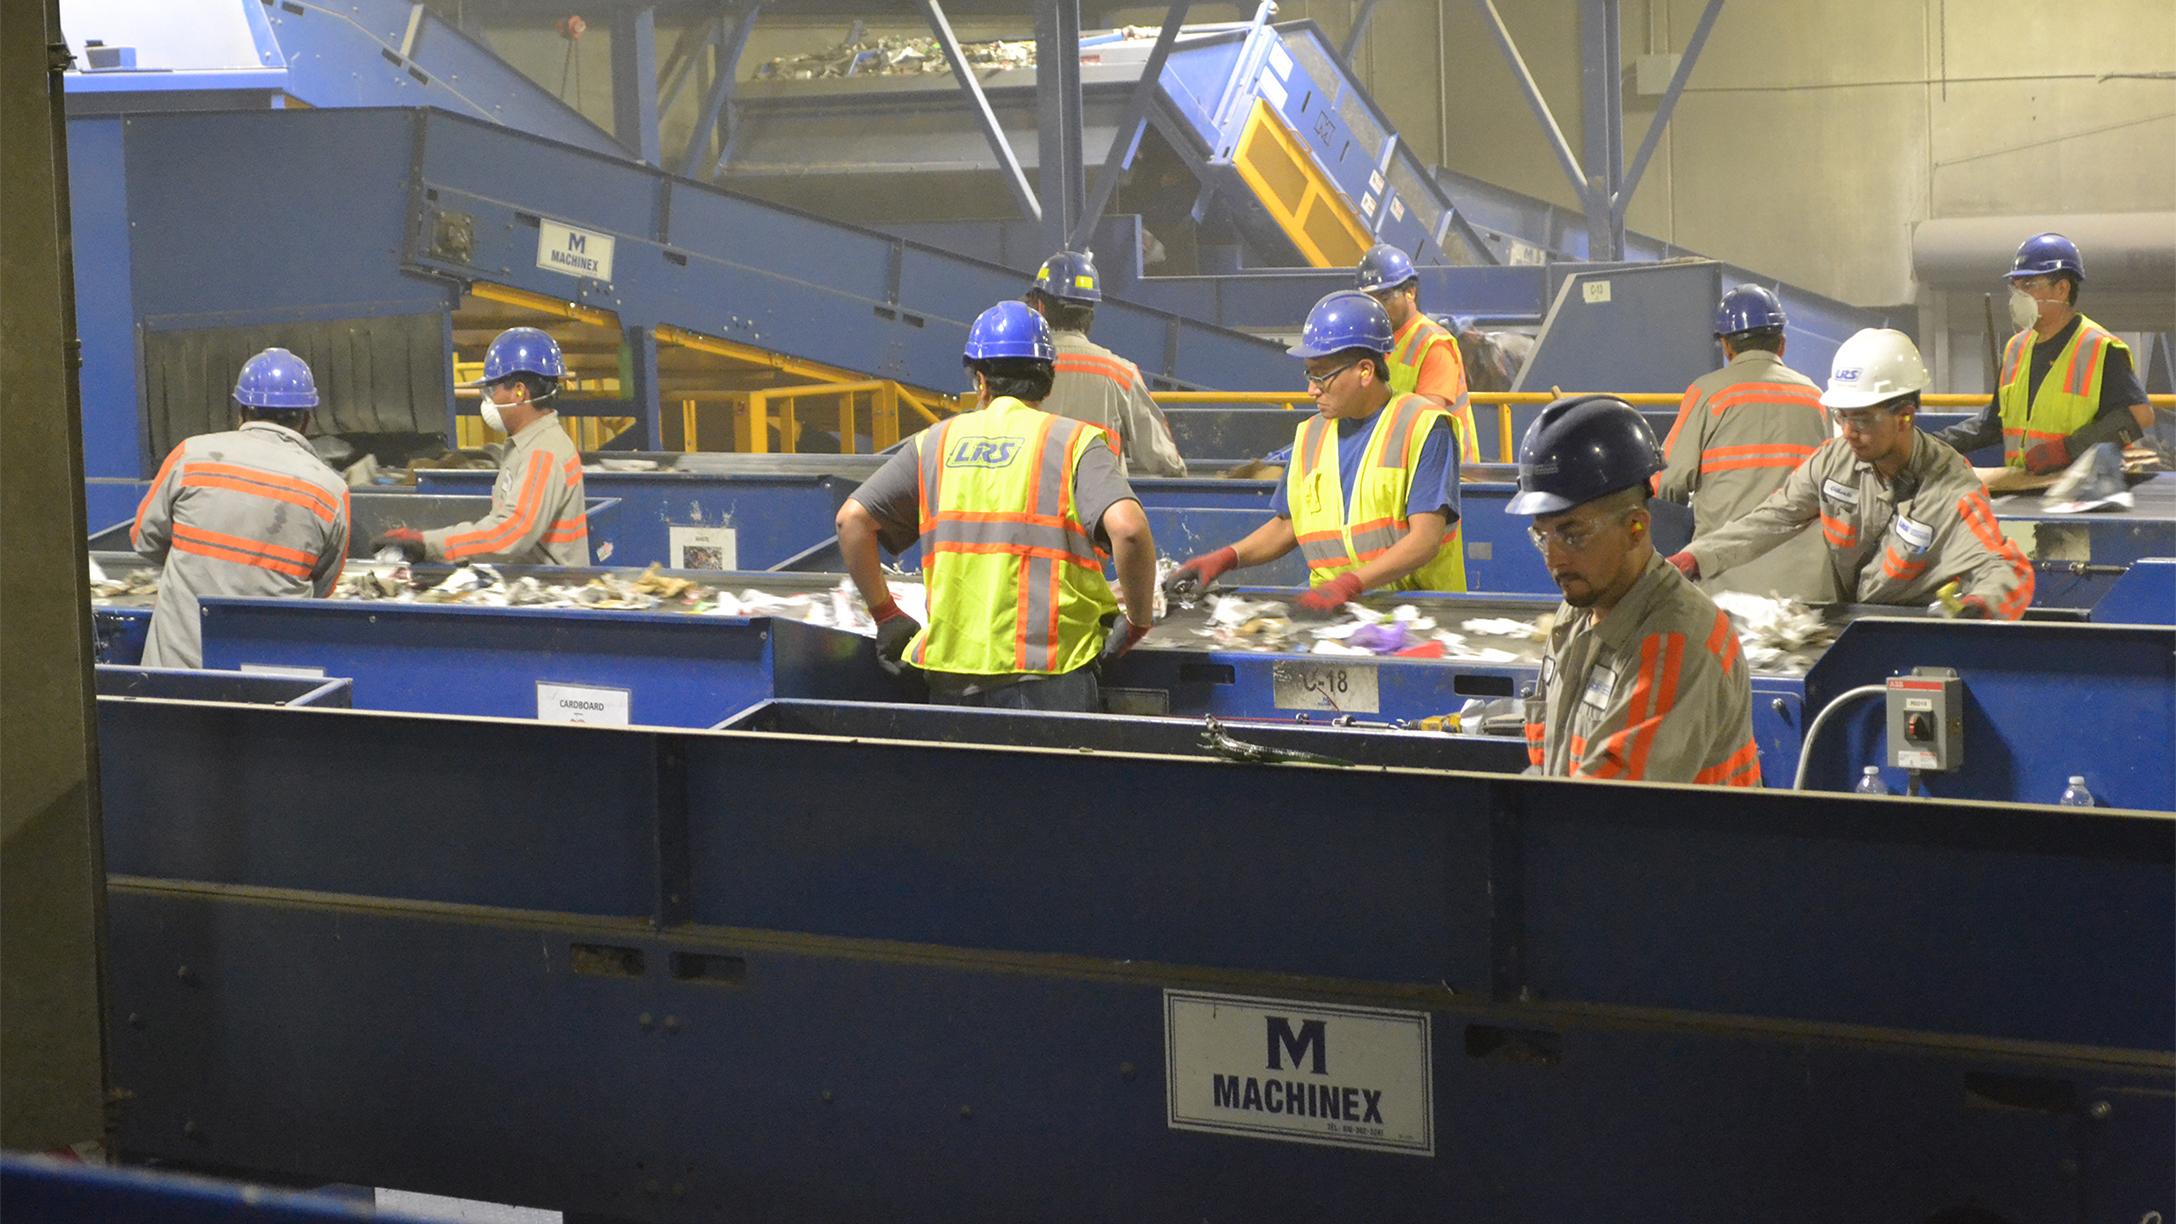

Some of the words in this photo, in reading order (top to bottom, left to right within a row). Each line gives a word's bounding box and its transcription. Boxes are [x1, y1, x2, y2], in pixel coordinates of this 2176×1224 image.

[568, 232, 586, 254] M
[551, 249, 599, 273] MACHINEX
[954, 442, 1015, 464] LRS
[1303, 667, 1348, 693] C-18
[559, 699, 605, 712] CARDBOARD
[1265, 1015, 1329, 1075] M
[1213, 1073, 1384, 1124] MACHINEX
